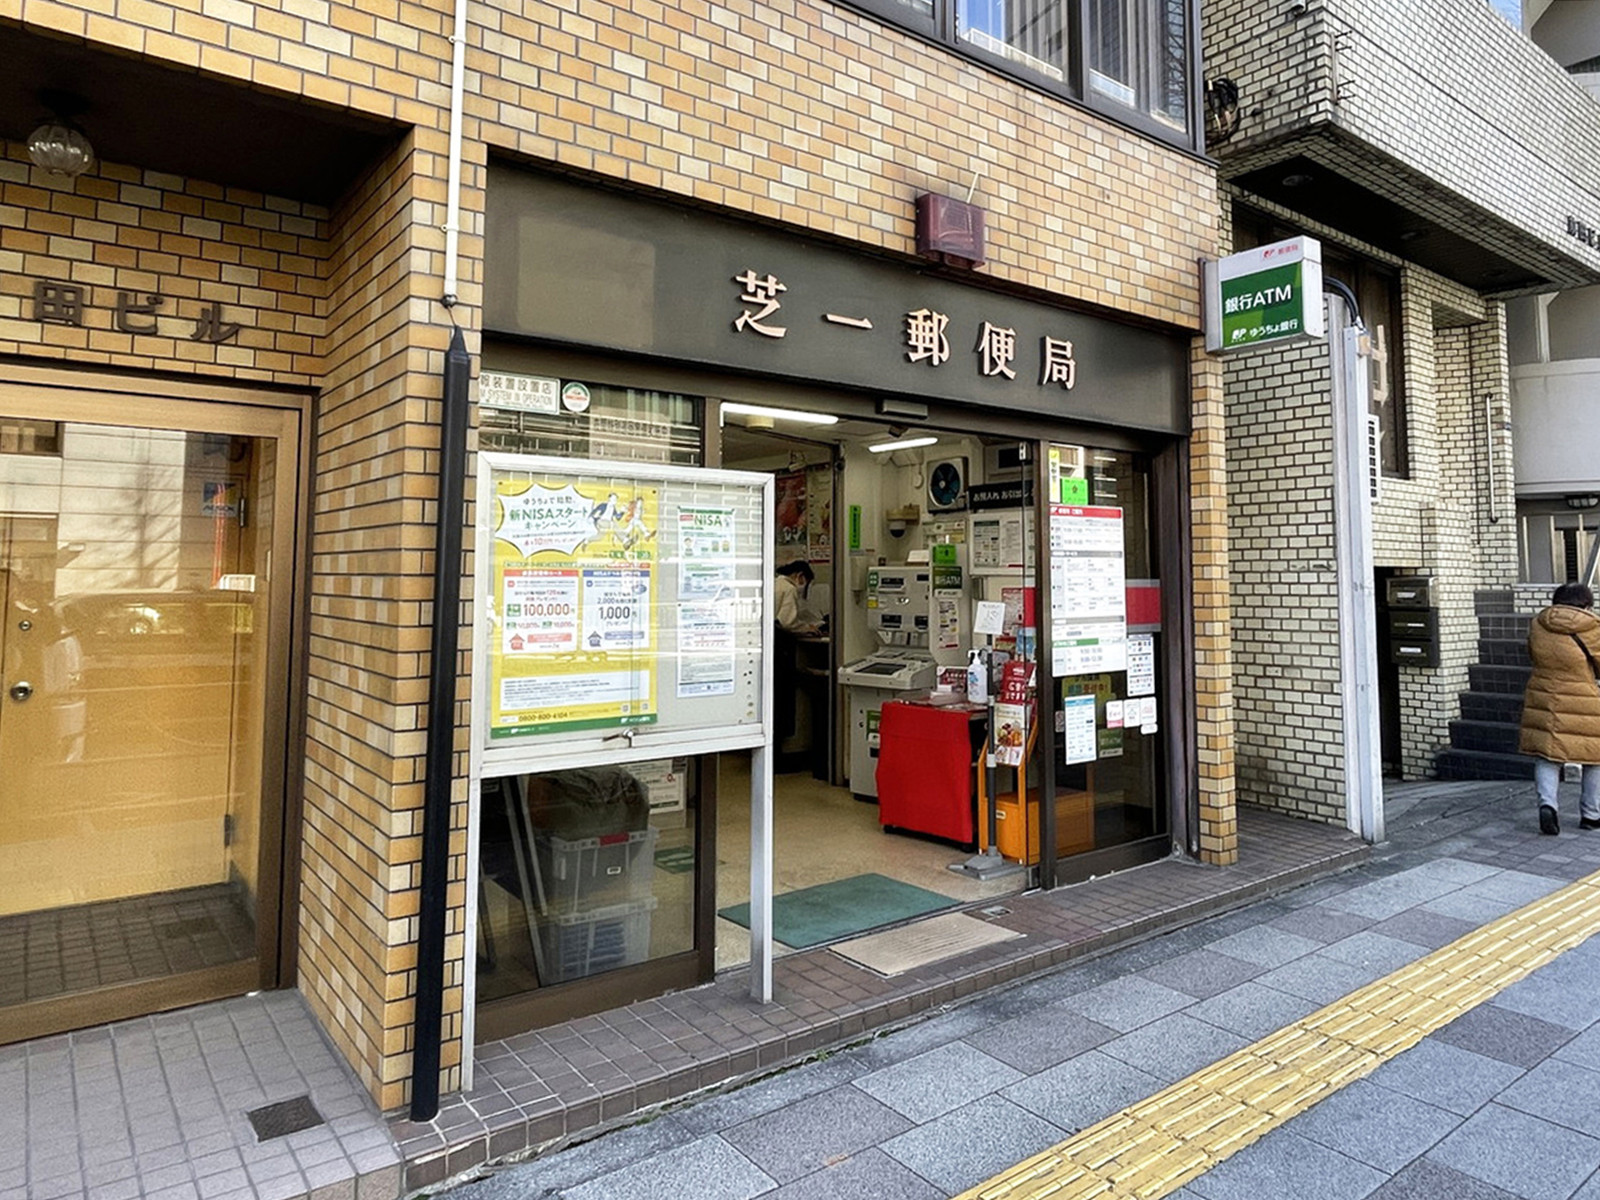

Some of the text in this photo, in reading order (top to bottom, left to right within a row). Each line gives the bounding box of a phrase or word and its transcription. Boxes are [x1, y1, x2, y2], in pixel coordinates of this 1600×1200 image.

[33, 280, 241, 343] 田ビル
[1225, 284, 1292, 314] 銀行ATM
[733, 269, 1077, 391] 芝一郵便局
[1249, 318, 1298, 338] ゆうちょ銀行
[509, 505, 588, 521] 新NISAスタート
[525, 519, 577, 531] キャンペーン
